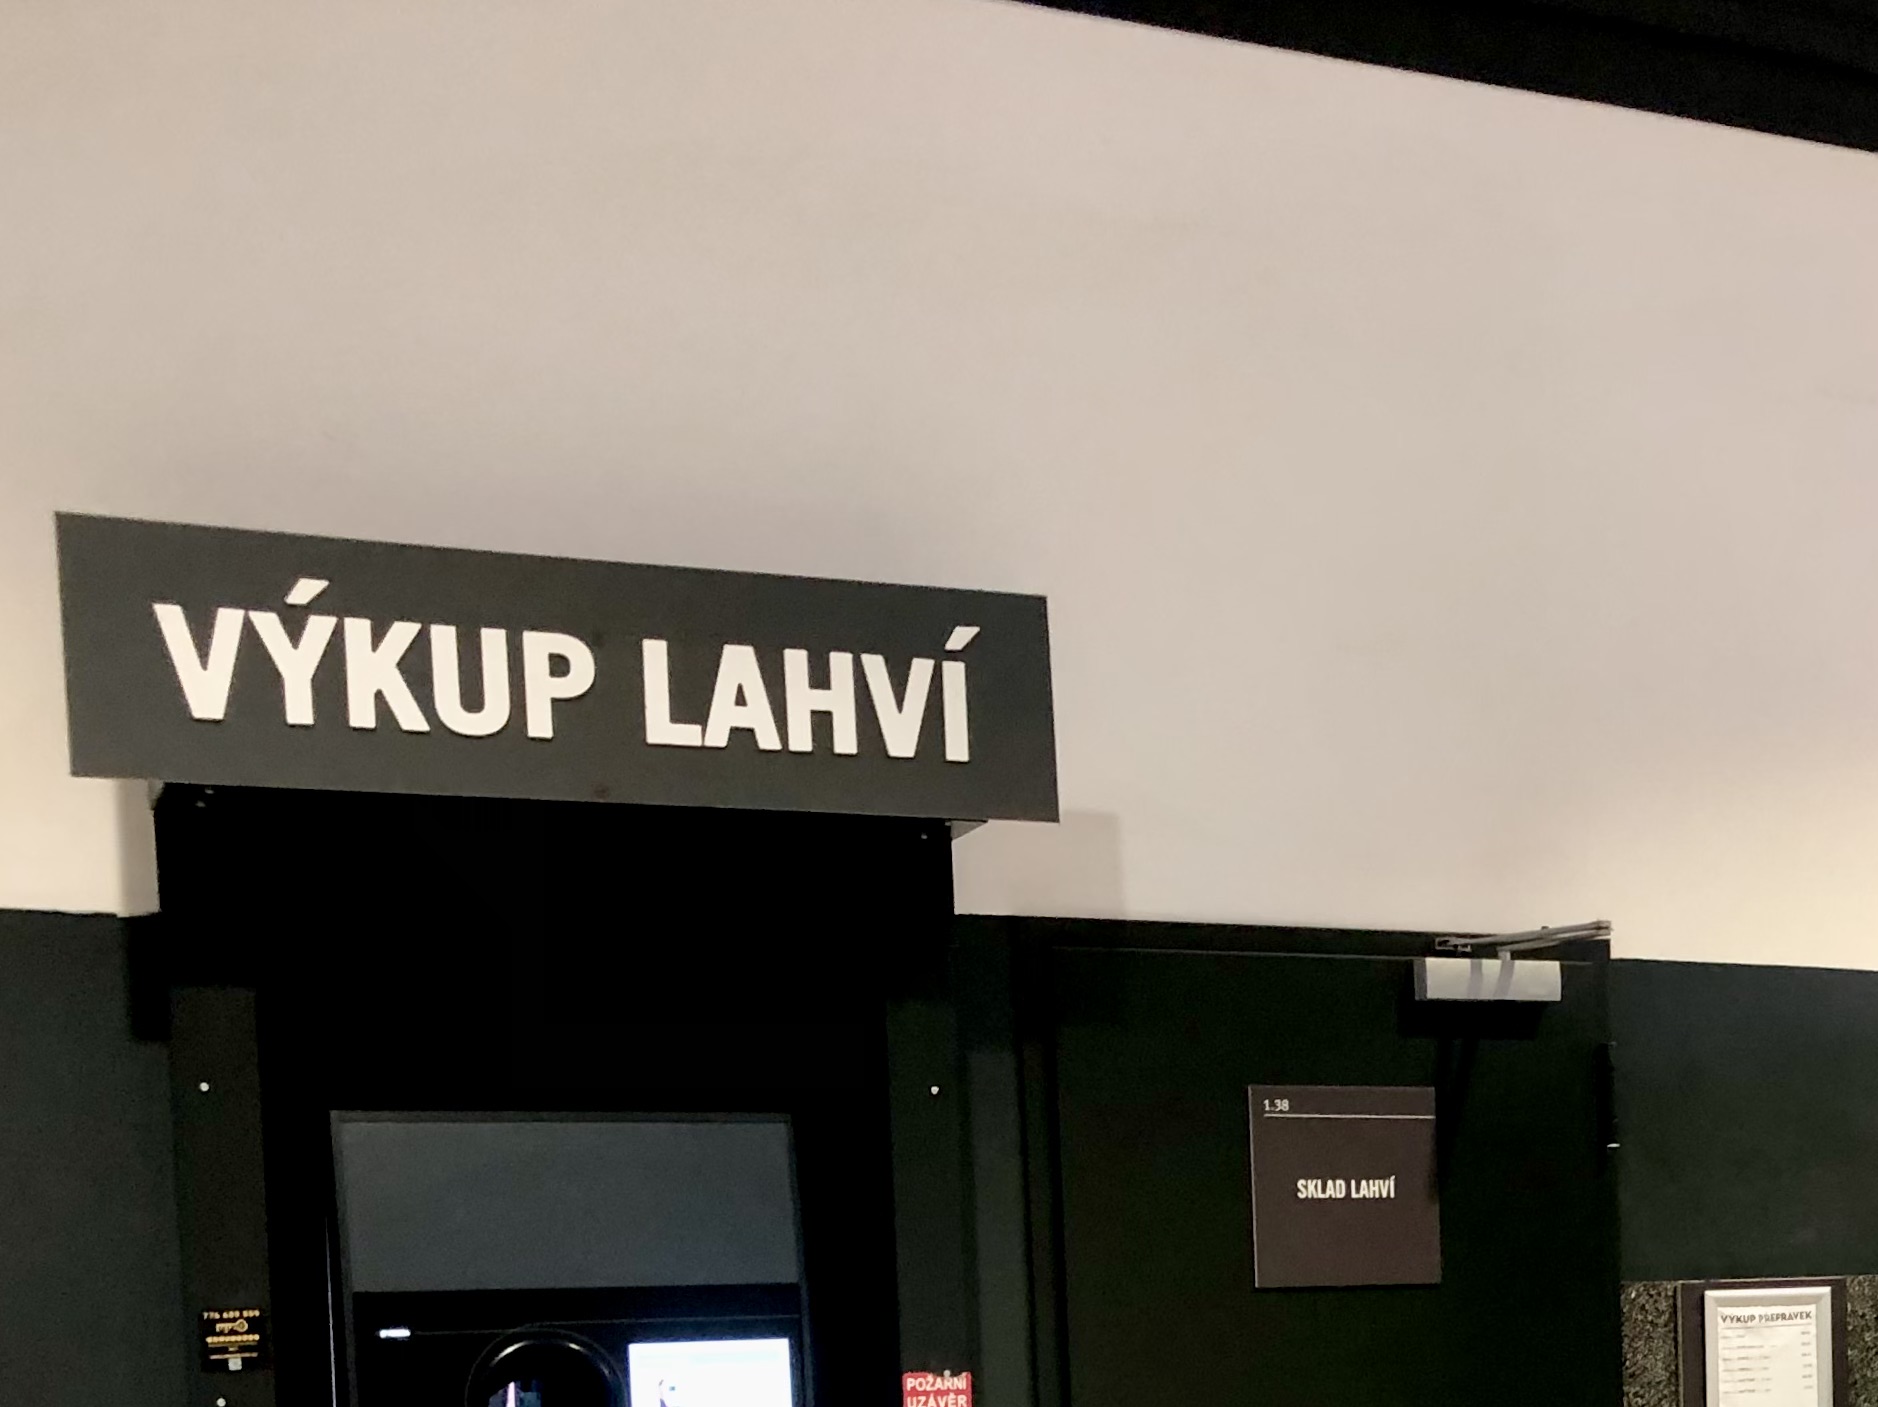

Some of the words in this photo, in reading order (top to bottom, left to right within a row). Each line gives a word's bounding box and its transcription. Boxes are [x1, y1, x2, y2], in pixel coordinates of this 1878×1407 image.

[152, 579, 596, 740] VÝKUP
[643, 626, 980, 762] LAHVÍ
[1263, 1098, 1290, 1112] 1.38
[1296, 1178, 1346, 1199] SKLAD
[1350, 1175, 1396, 1199] LAHVÍ
[1720, 1313, 1756, 1324] VÝKUP
[1758, 1310, 1813, 1323] PŘEPRAVEK
[906, 1374, 967, 1392] POŽÁRNÍ
